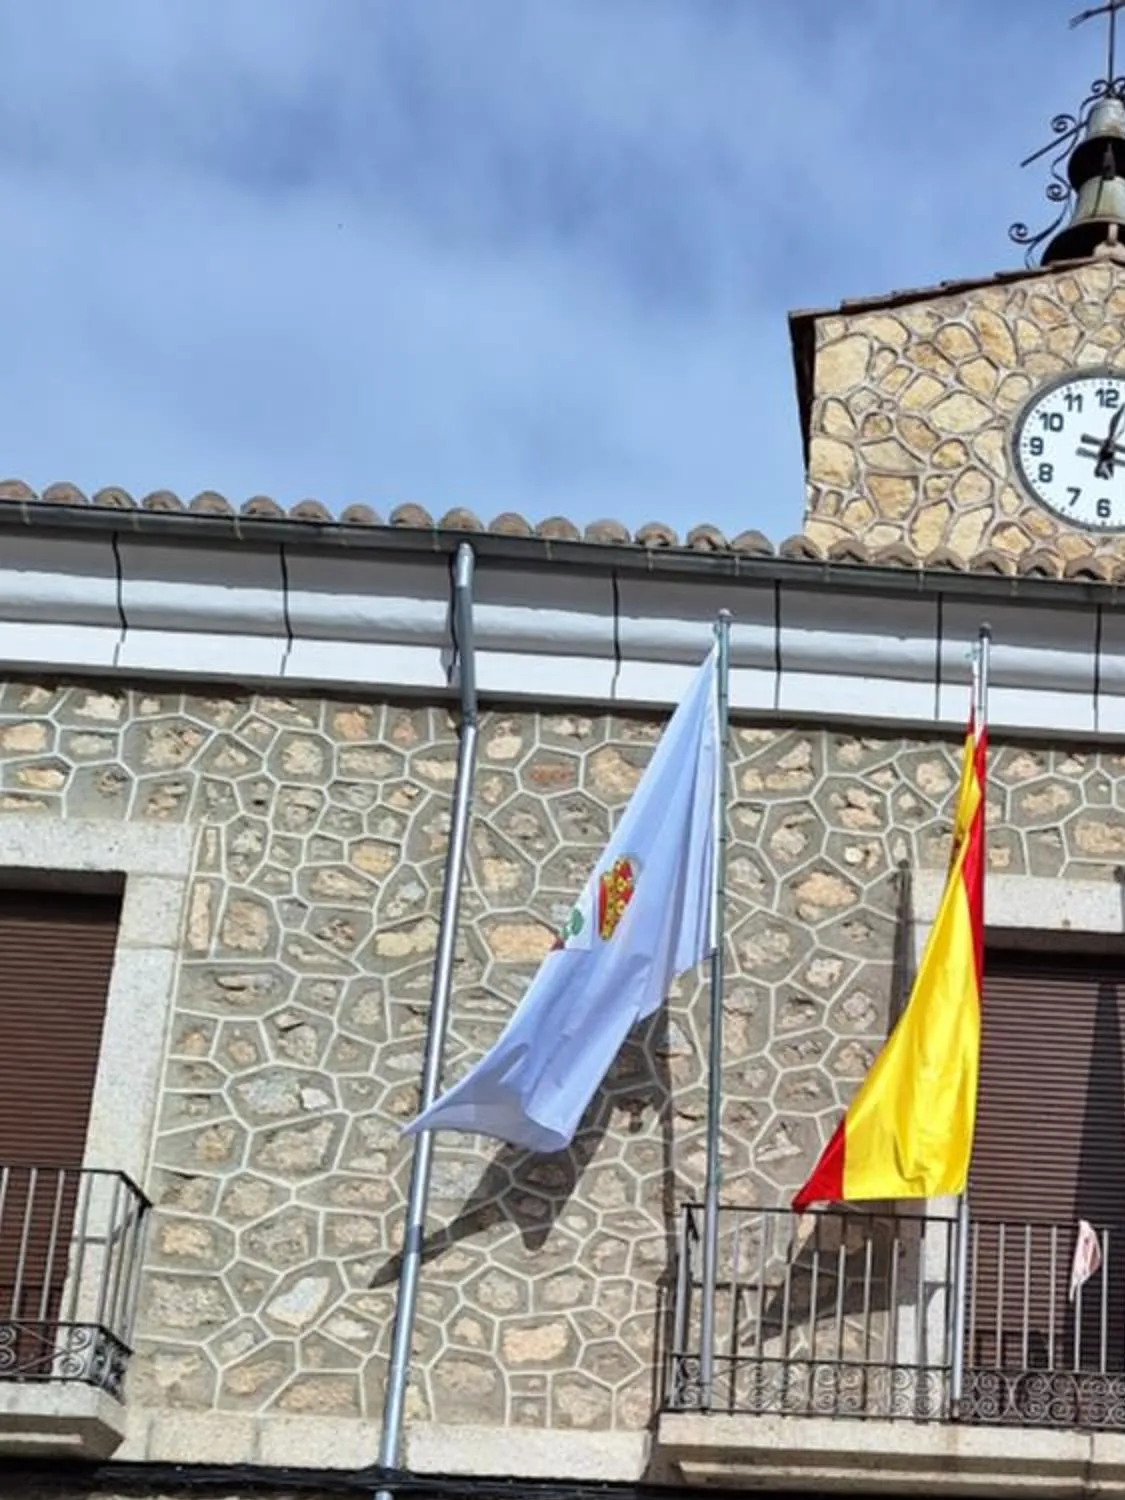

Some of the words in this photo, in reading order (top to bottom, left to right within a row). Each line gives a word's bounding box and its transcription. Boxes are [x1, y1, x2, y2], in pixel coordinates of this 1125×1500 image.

[1064, 393, 1084, 413] 11
[1095, 389, 1120, 409] 12
[1039, 413, 1064, 432] 10
[1029, 437, 1044, 456] 9
[1038, 463, 1054, 483] 8
[1066, 487, 1082, 506] 7
[1096, 499, 1111, 518] 6
